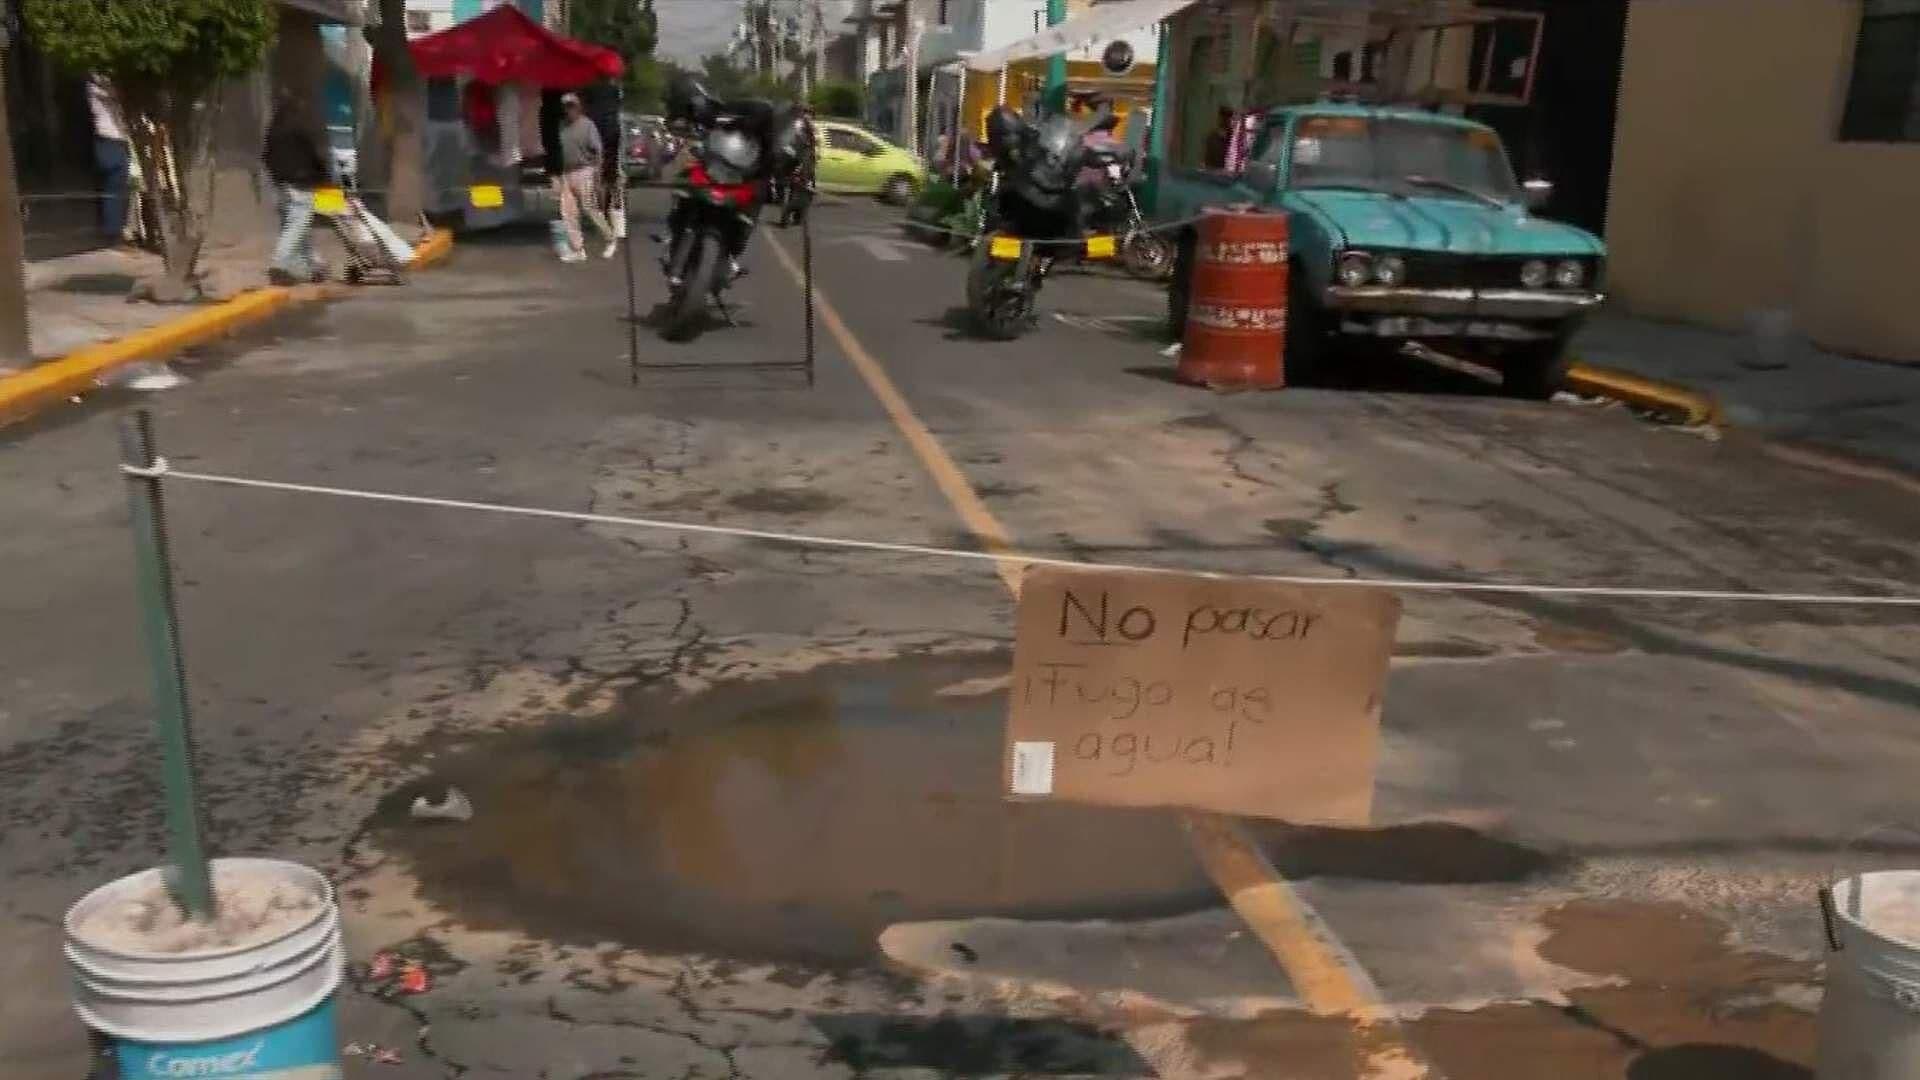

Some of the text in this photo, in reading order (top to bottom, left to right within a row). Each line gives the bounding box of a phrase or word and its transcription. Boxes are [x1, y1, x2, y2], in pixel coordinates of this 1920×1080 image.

[1059, 588, 1323, 649] No pasar
[1073, 721, 1238, 776] agua!
